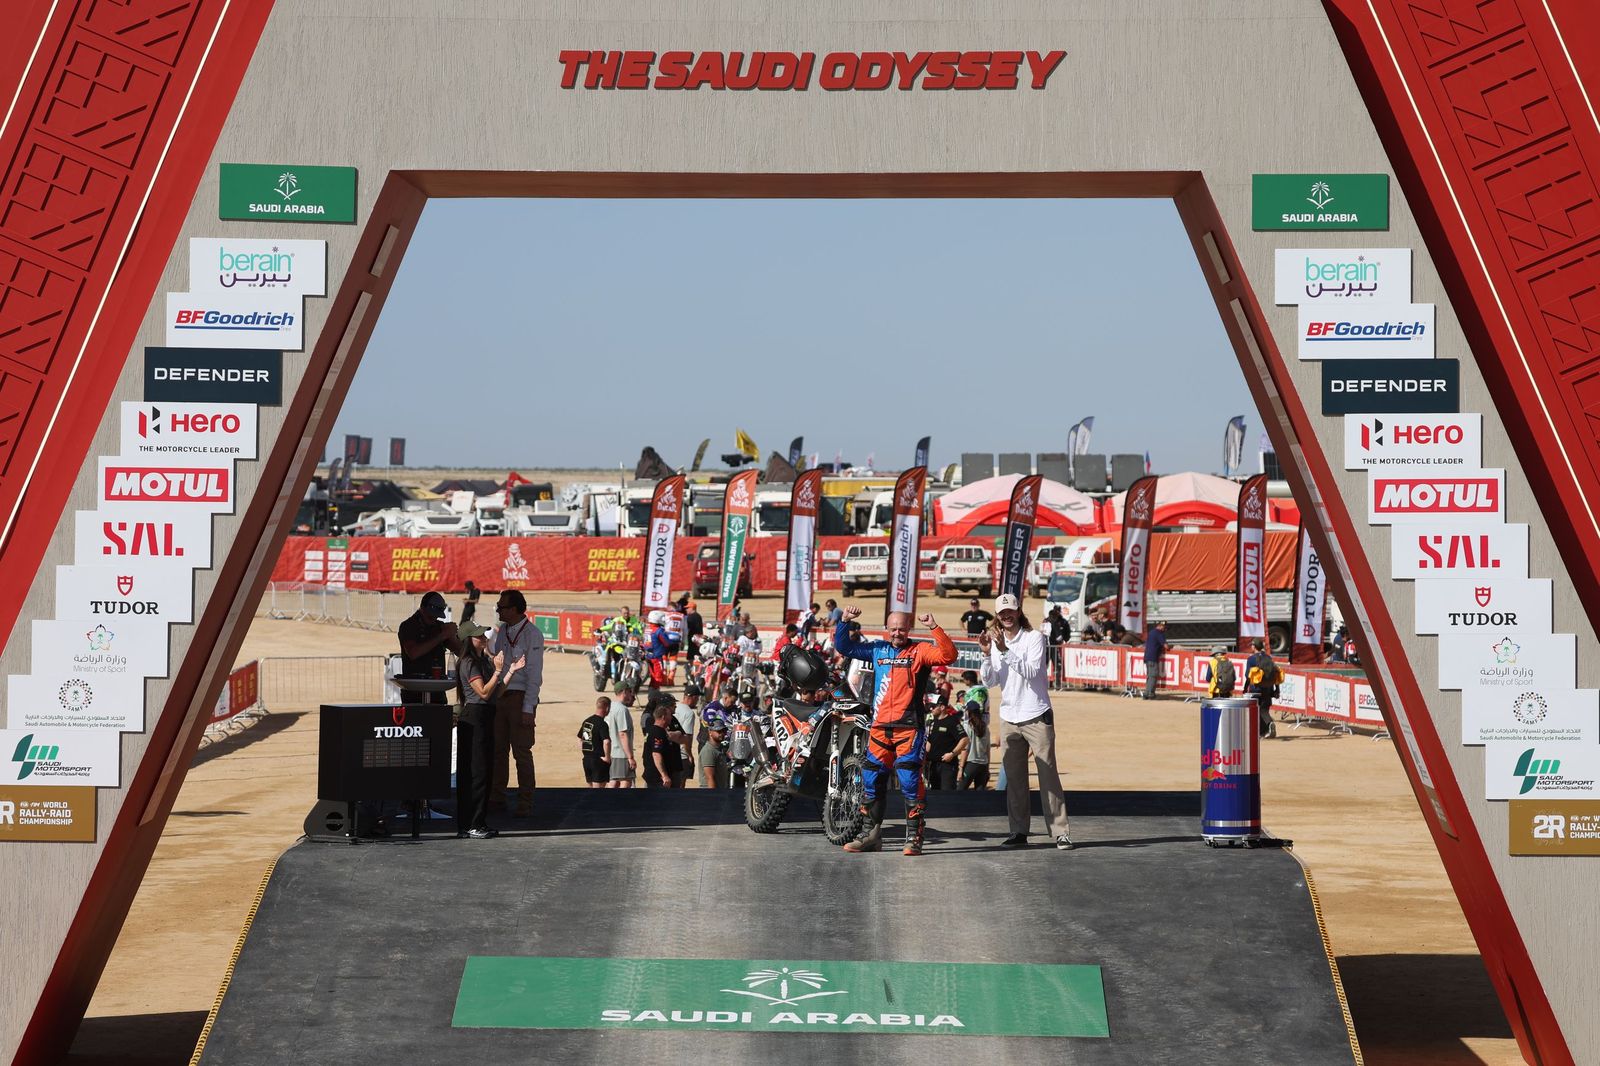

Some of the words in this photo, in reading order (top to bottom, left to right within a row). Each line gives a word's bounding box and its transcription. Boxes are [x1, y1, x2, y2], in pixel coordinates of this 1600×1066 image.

[560, 50, 654, 90] THE
[653, 51, 815, 90] SAUDI
[818, 50, 1067, 90] ODYSSEY
[249, 203, 281, 214] SAUDI
[283, 204, 325, 214] ARABIA
[1282, 214, 1314, 222] SAUDI
[1317, 214, 1358, 222] ARABIA
[220, 246, 292, 272] berain
[1306, 256, 1378, 281] berain
[220, 273, 292, 288] بيرين
[1306, 282, 1378, 298] بيرين
[176, 310, 294, 326] BFGoodrich
[1306, 322, 1426, 336] BFGoodrich
[154, 367, 270, 383] DEFENDER
[1331, 379, 1447, 392] DEFENDER
[171, 413, 240, 433] Hero
[1394, 424, 1464, 444] Hero
[110, 472, 223, 498] MOTUL
[1380, 483, 1493, 508] MOTUL
[392, 548, 444, 558] DREAM.
[588, 549, 640, 559] DREAM.
[392, 560, 432, 570] DARE.
[588, 560, 627, 570] DARE.
[653, 538, 668, 588] TUDOR
[896, 524, 909, 603] BFGoodrich
[1008, 528, 1025, 594] FENDER
[392, 571, 424, 581] LIVE
[424, 570, 439, 580] IT.
[502, 568, 529, 580] DAKAR
[588, 571, 620, 582] LIVE
[621, 570, 635, 581] IT.
[723, 573, 732, 598] SAUDI
[728, 540, 738, 572] ARABIA
[1128, 544, 1142, 594] Hero
[1246, 546, 1258, 620] MOTUL
[1305, 554, 1320, 620] TUDOR
[90, 600, 159, 614] TUDOR
[1448, 613, 1518, 626] TUDOR
[73, 653, 103, 664] الرياضة
[106, 654, 127, 665] وزارة
[861, 660, 873, 670] 10
[1086, 654, 1106, 667] Hero
[1480, 667, 1510, 677] الرياضة
[1512, 668, 1534, 677] وزارة
[374, 726, 423, 738] TUDOR
[1212, 750, 1241, 766] Bull
[0, 800, 14, 824] R
[20, 808, 72, 818] RALLY-RAID
[1570, 822, 1600, 831] RALLY-
[601, 1010, 751, 1023] SAUDI
[768, 1012, 965, 1027] ARABIA
